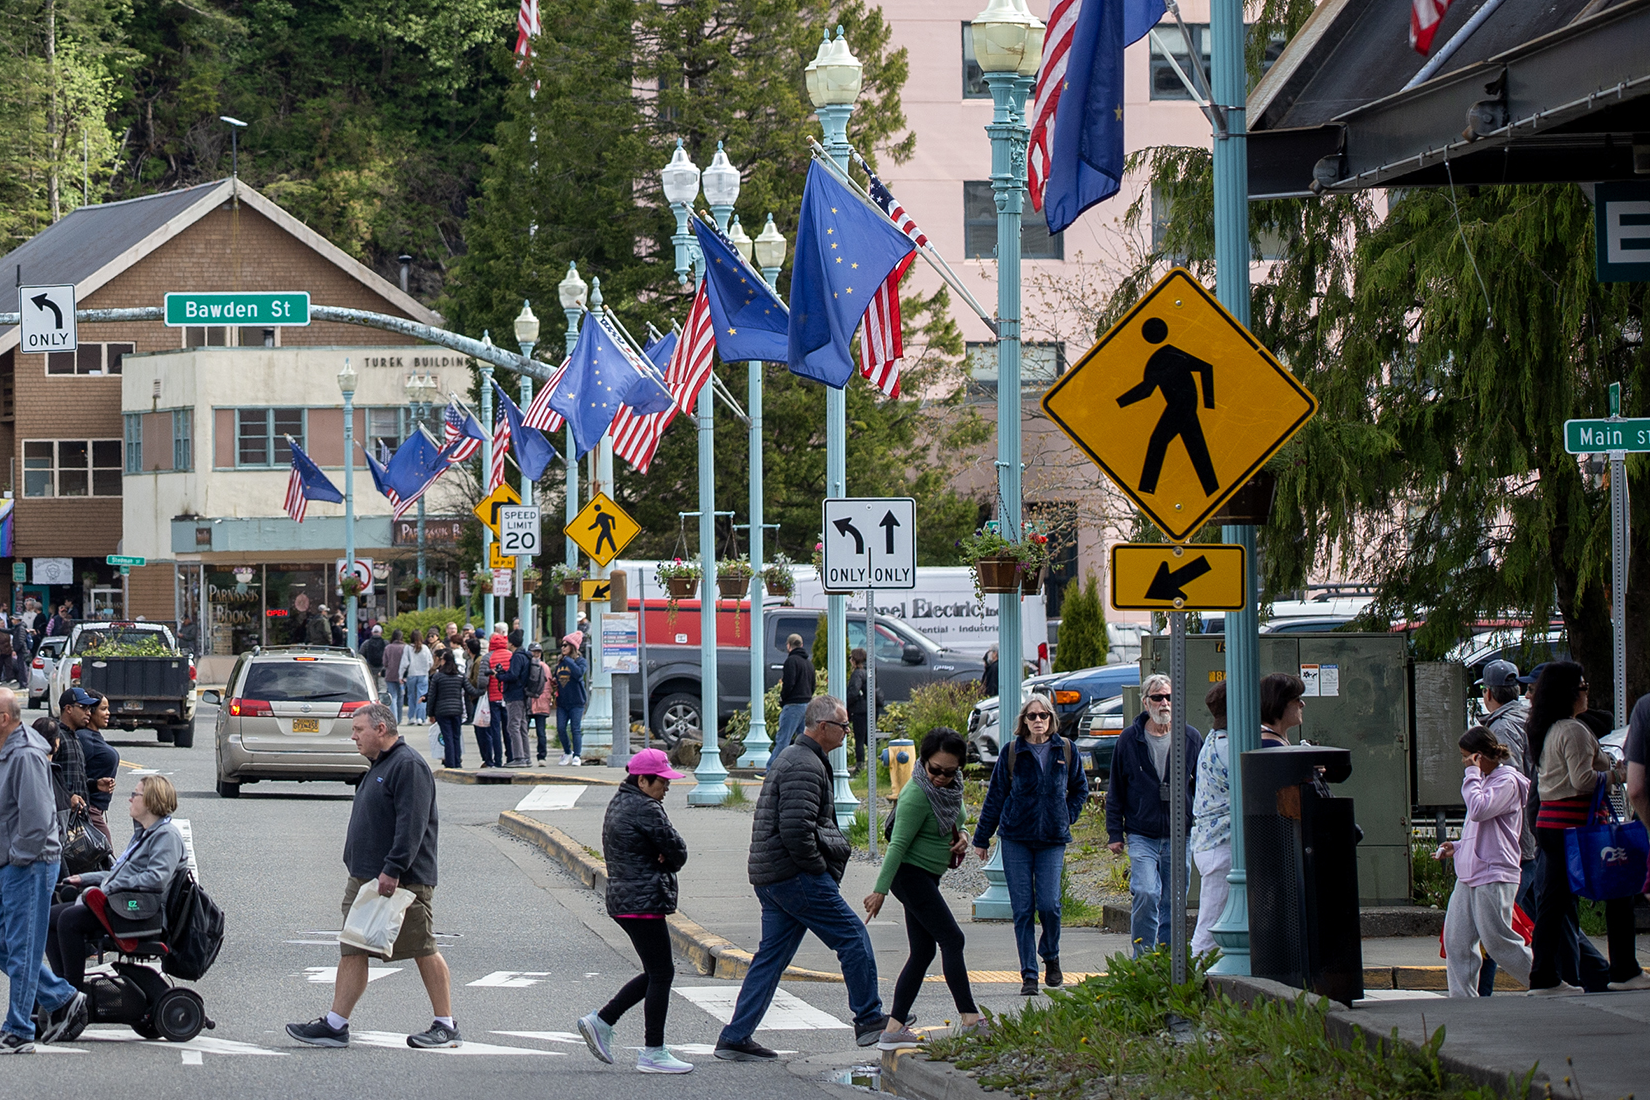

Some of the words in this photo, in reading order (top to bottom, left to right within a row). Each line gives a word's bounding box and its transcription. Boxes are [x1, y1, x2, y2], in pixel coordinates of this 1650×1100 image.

[186, 301, 258, 318] Bawden
[271, 300, 291, 317] St
[29, 332, 69, 347] ONLY
[364, 357, 404, 368] TUREK
[1580, 427, 1622, 446] Main
[504, 511, 537, 519] SPEED
[507, 521, 533, 530] LIMIT
[506, 531, 536, 550] 20
[496, 545, 509, 558] 1
[830, 568, 866, 582] ONLY
[875, 568, 910, 582] ONLY
[216, 605, 251, 623] BOOKS
[266, 609, 288, 617] OPEN
